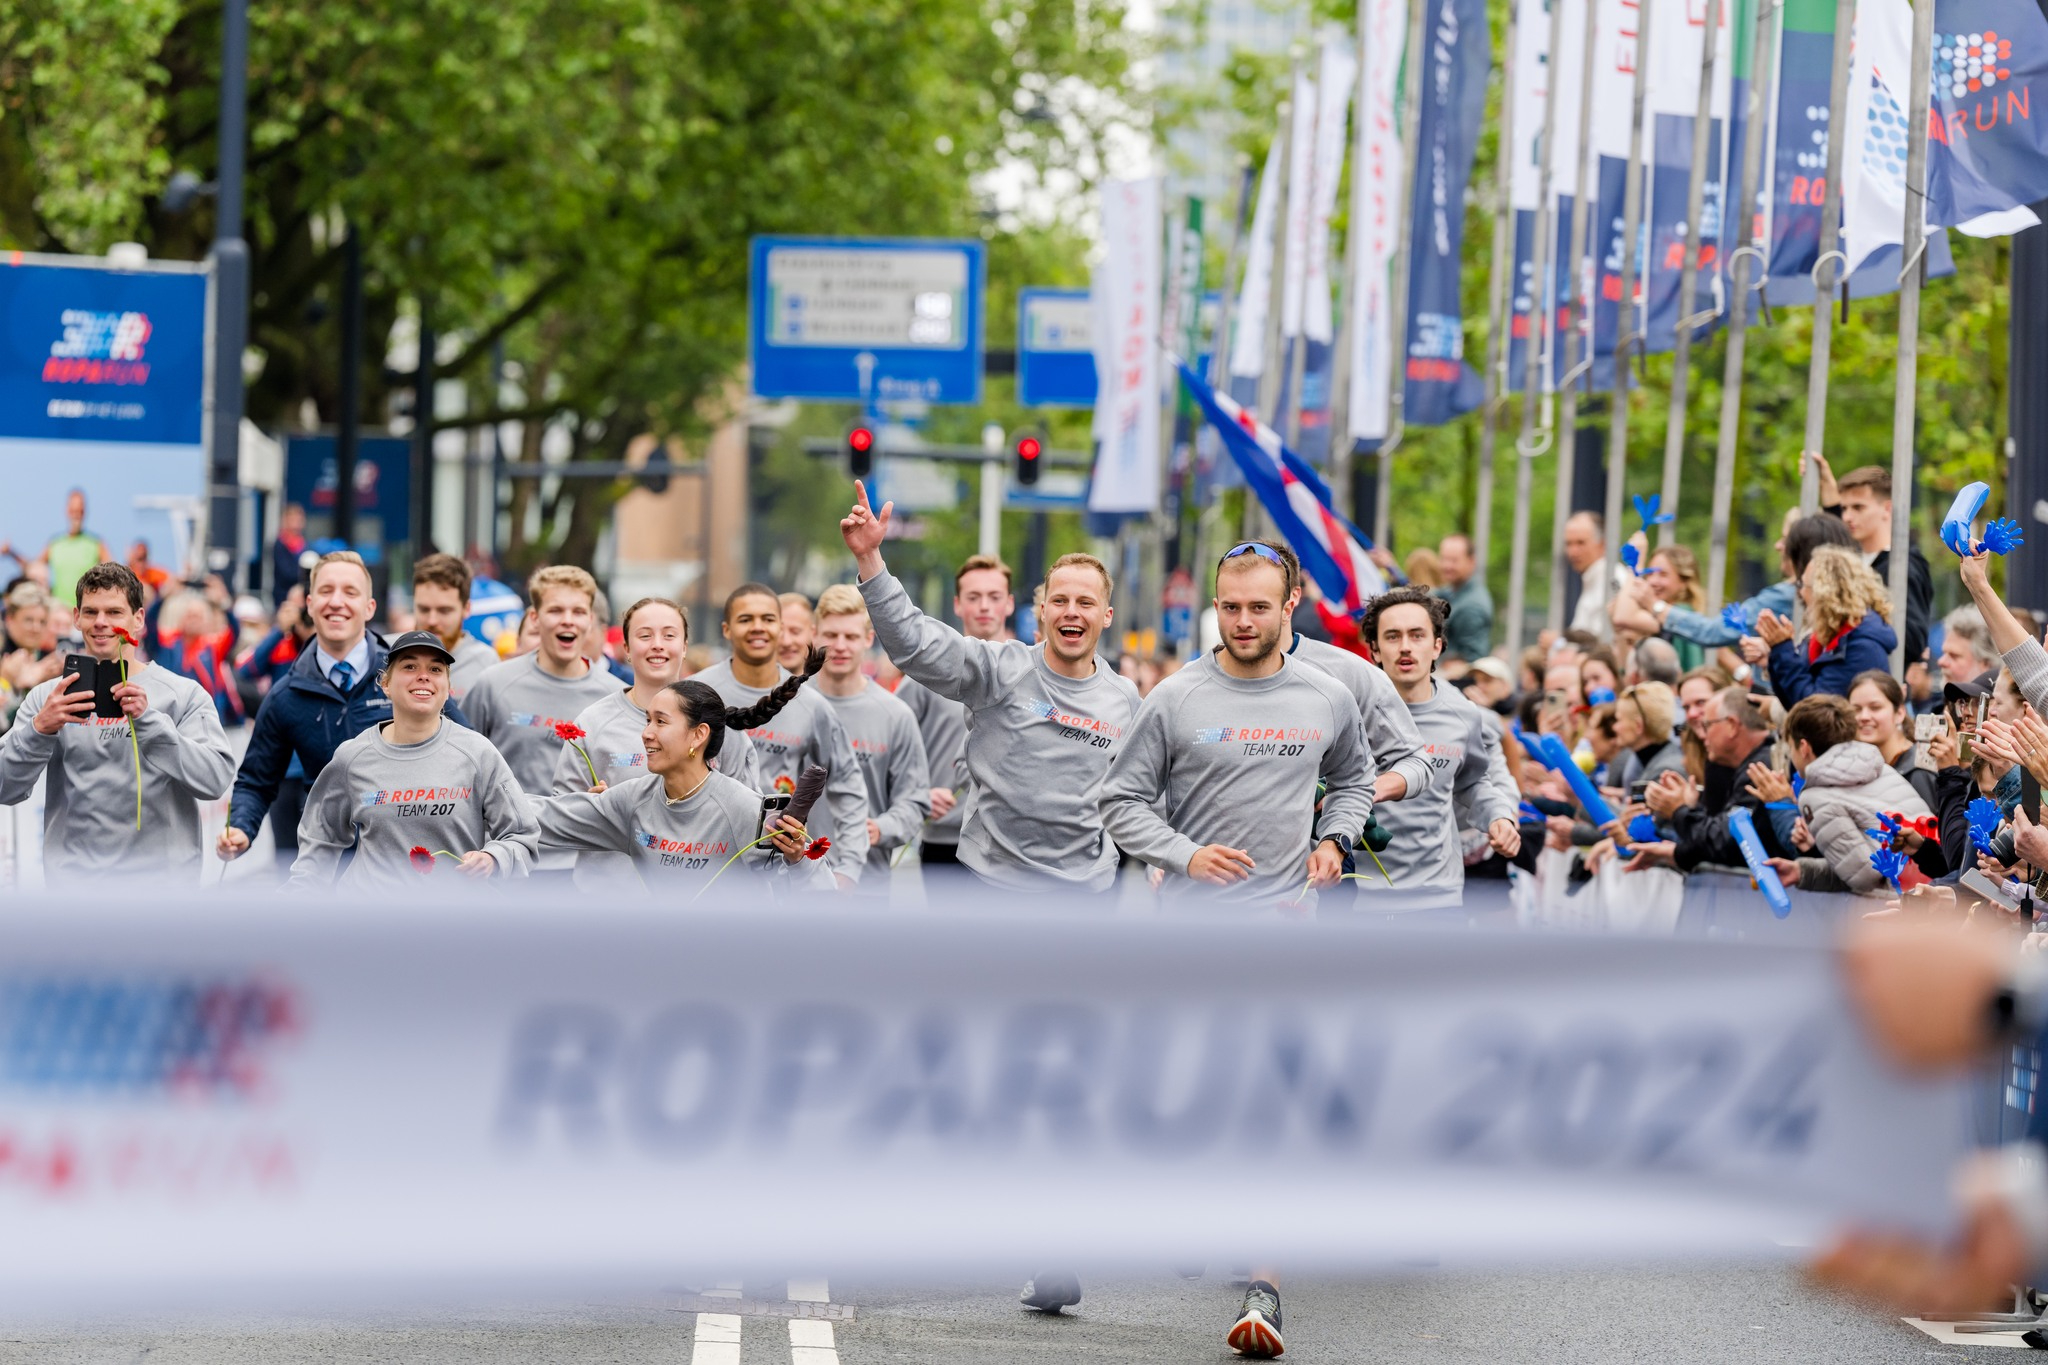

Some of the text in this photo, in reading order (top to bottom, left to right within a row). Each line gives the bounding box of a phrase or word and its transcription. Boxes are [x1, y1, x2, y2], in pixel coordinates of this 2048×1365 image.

[99, 727, 124, 740] TEAM
[1060, 715, 1123, 739] ROPARUN
[1238, 728, 1322, 741] ROPARUN
[745, 728, 802, 746] OPARUN
[1059, 726, 1112, 749] TEAM 207
[1243, 743, 1305, 756] TEAM 207
[391, 788, 472, 803] ROPARUN
[397, 803, 456, 817] TEAM 207
[659, 839, 729, 855] ROPARUN
[660, 853, 709, 869] TEAM 207
[494, 1000, 1832, 1168] ROPARUN 2024
